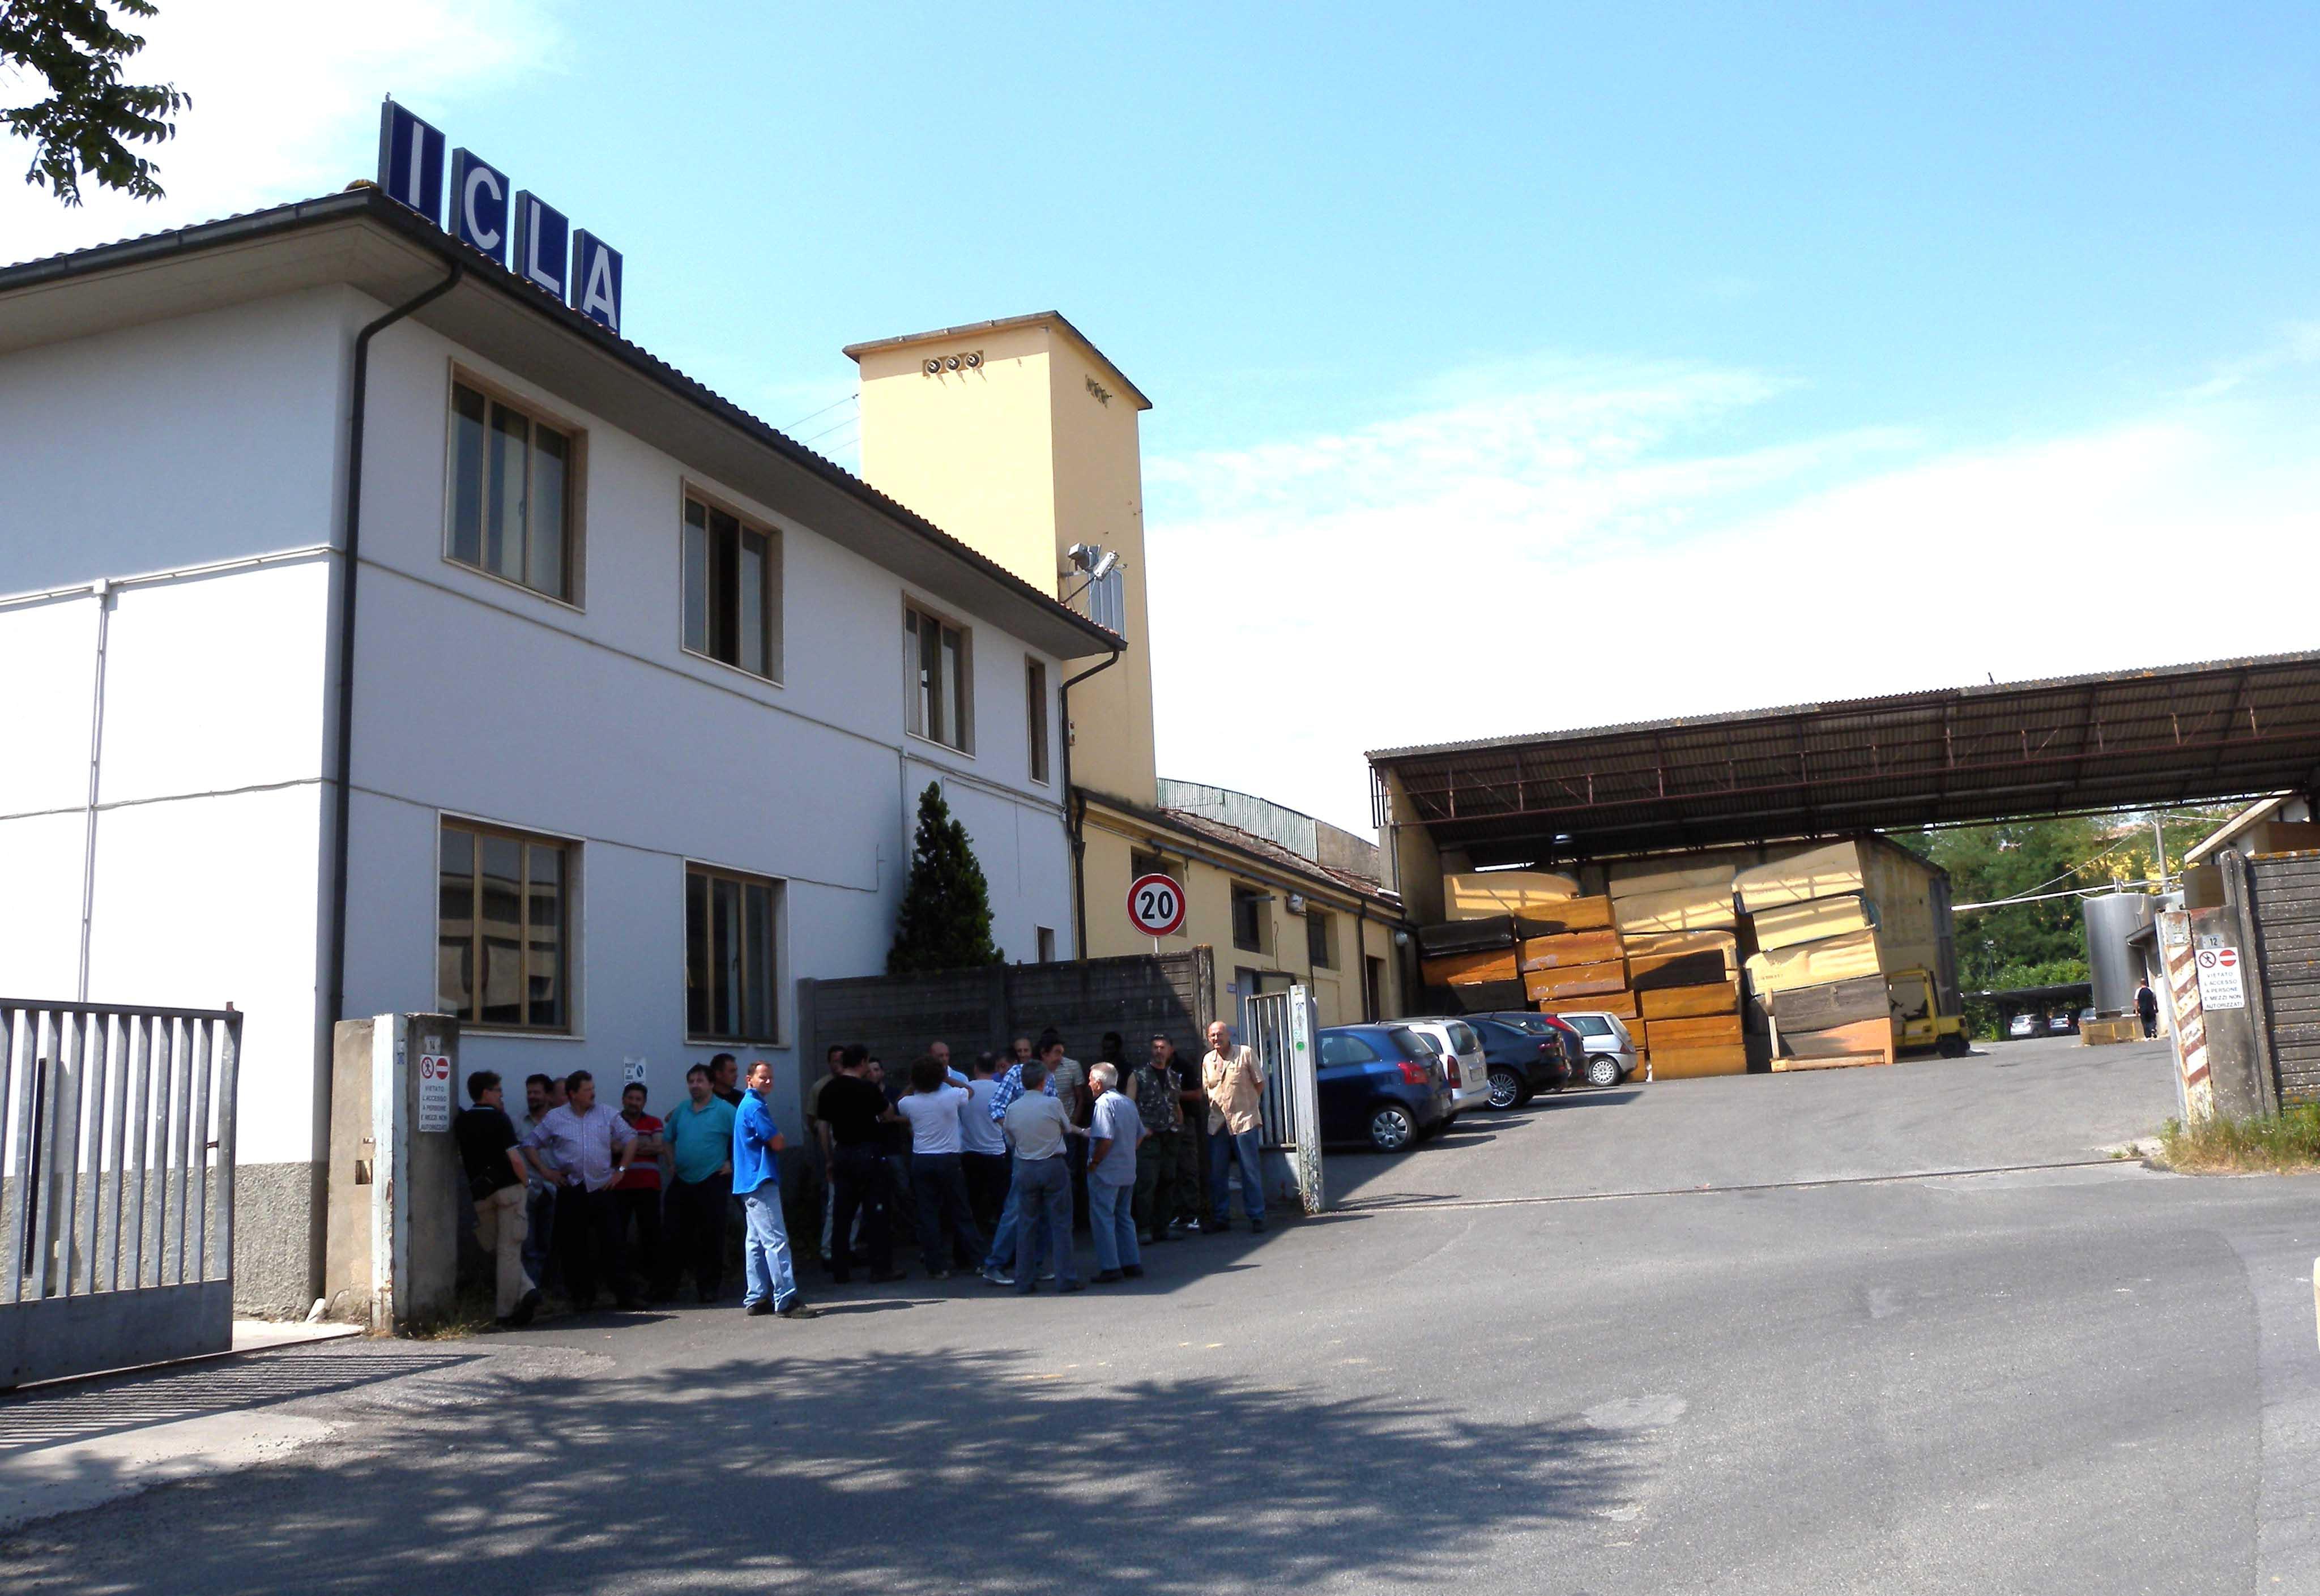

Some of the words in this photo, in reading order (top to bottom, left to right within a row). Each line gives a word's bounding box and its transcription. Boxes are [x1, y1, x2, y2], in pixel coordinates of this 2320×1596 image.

[409, 121, 618, 330] ICLA
[1140, 891, 1174, 919] 20
[2210, 937, 2217, 946] 12
